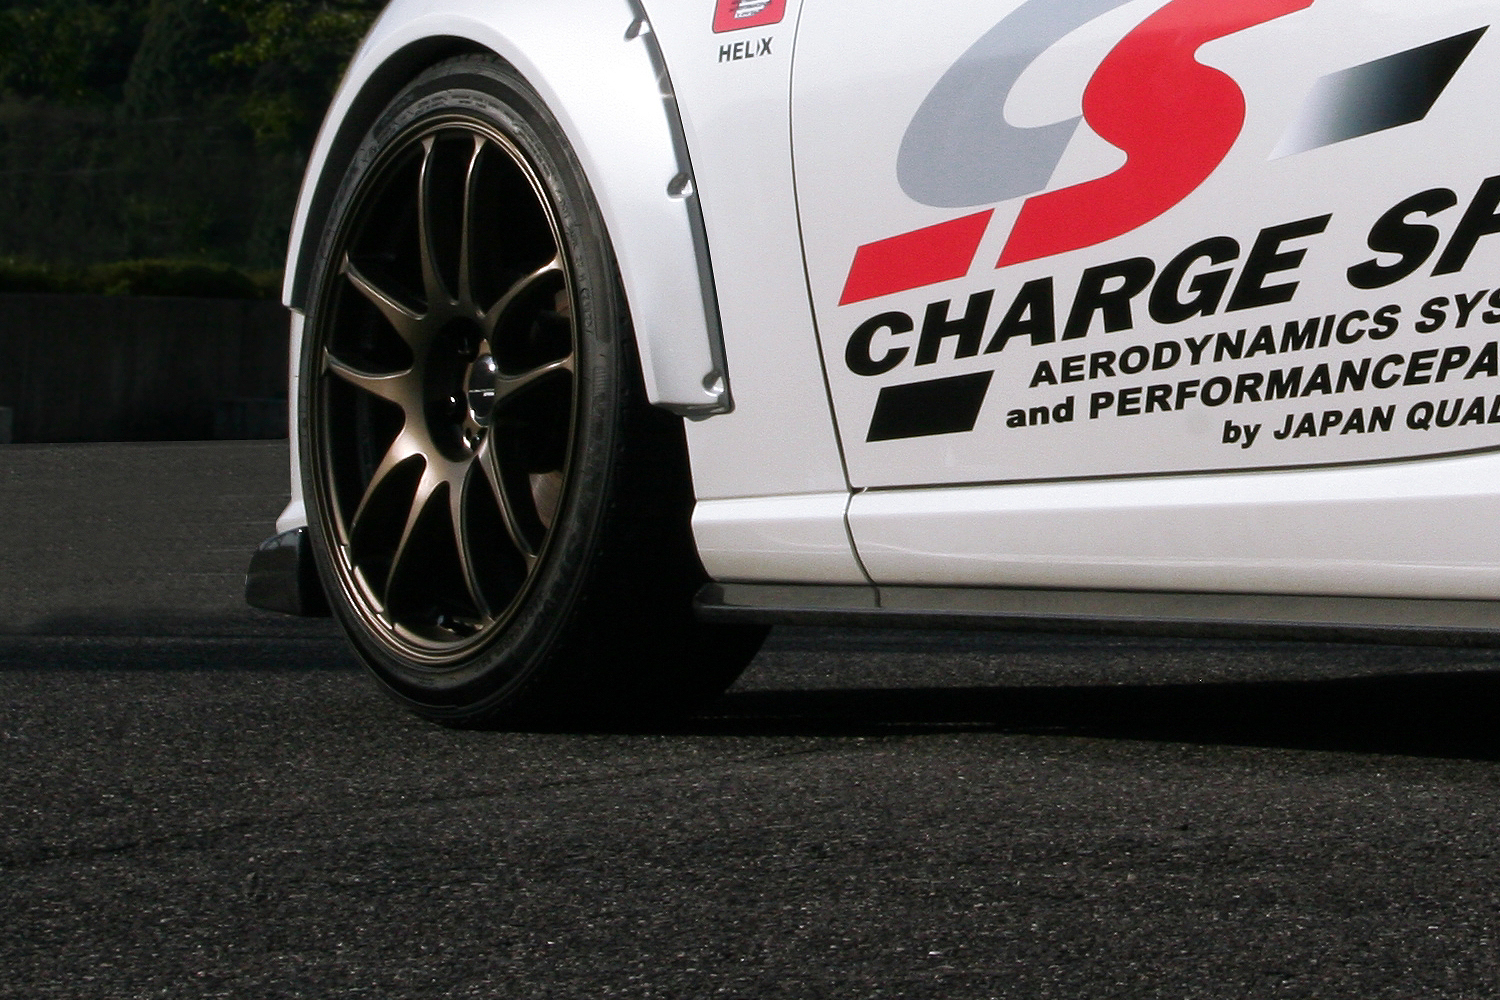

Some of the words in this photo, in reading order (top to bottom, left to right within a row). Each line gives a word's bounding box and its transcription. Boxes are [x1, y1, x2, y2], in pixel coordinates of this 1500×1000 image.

[718, 36, 774, 63] HELIX
[845, 213, 1333, 377] CHARGE
[1029, 304, 1402, 388] AERODYNAMICS
[1006, 395, 1075, 428] and
[1222, 419, 1262, 449] by
[1273, 404, 1396, 440] JAPAN
